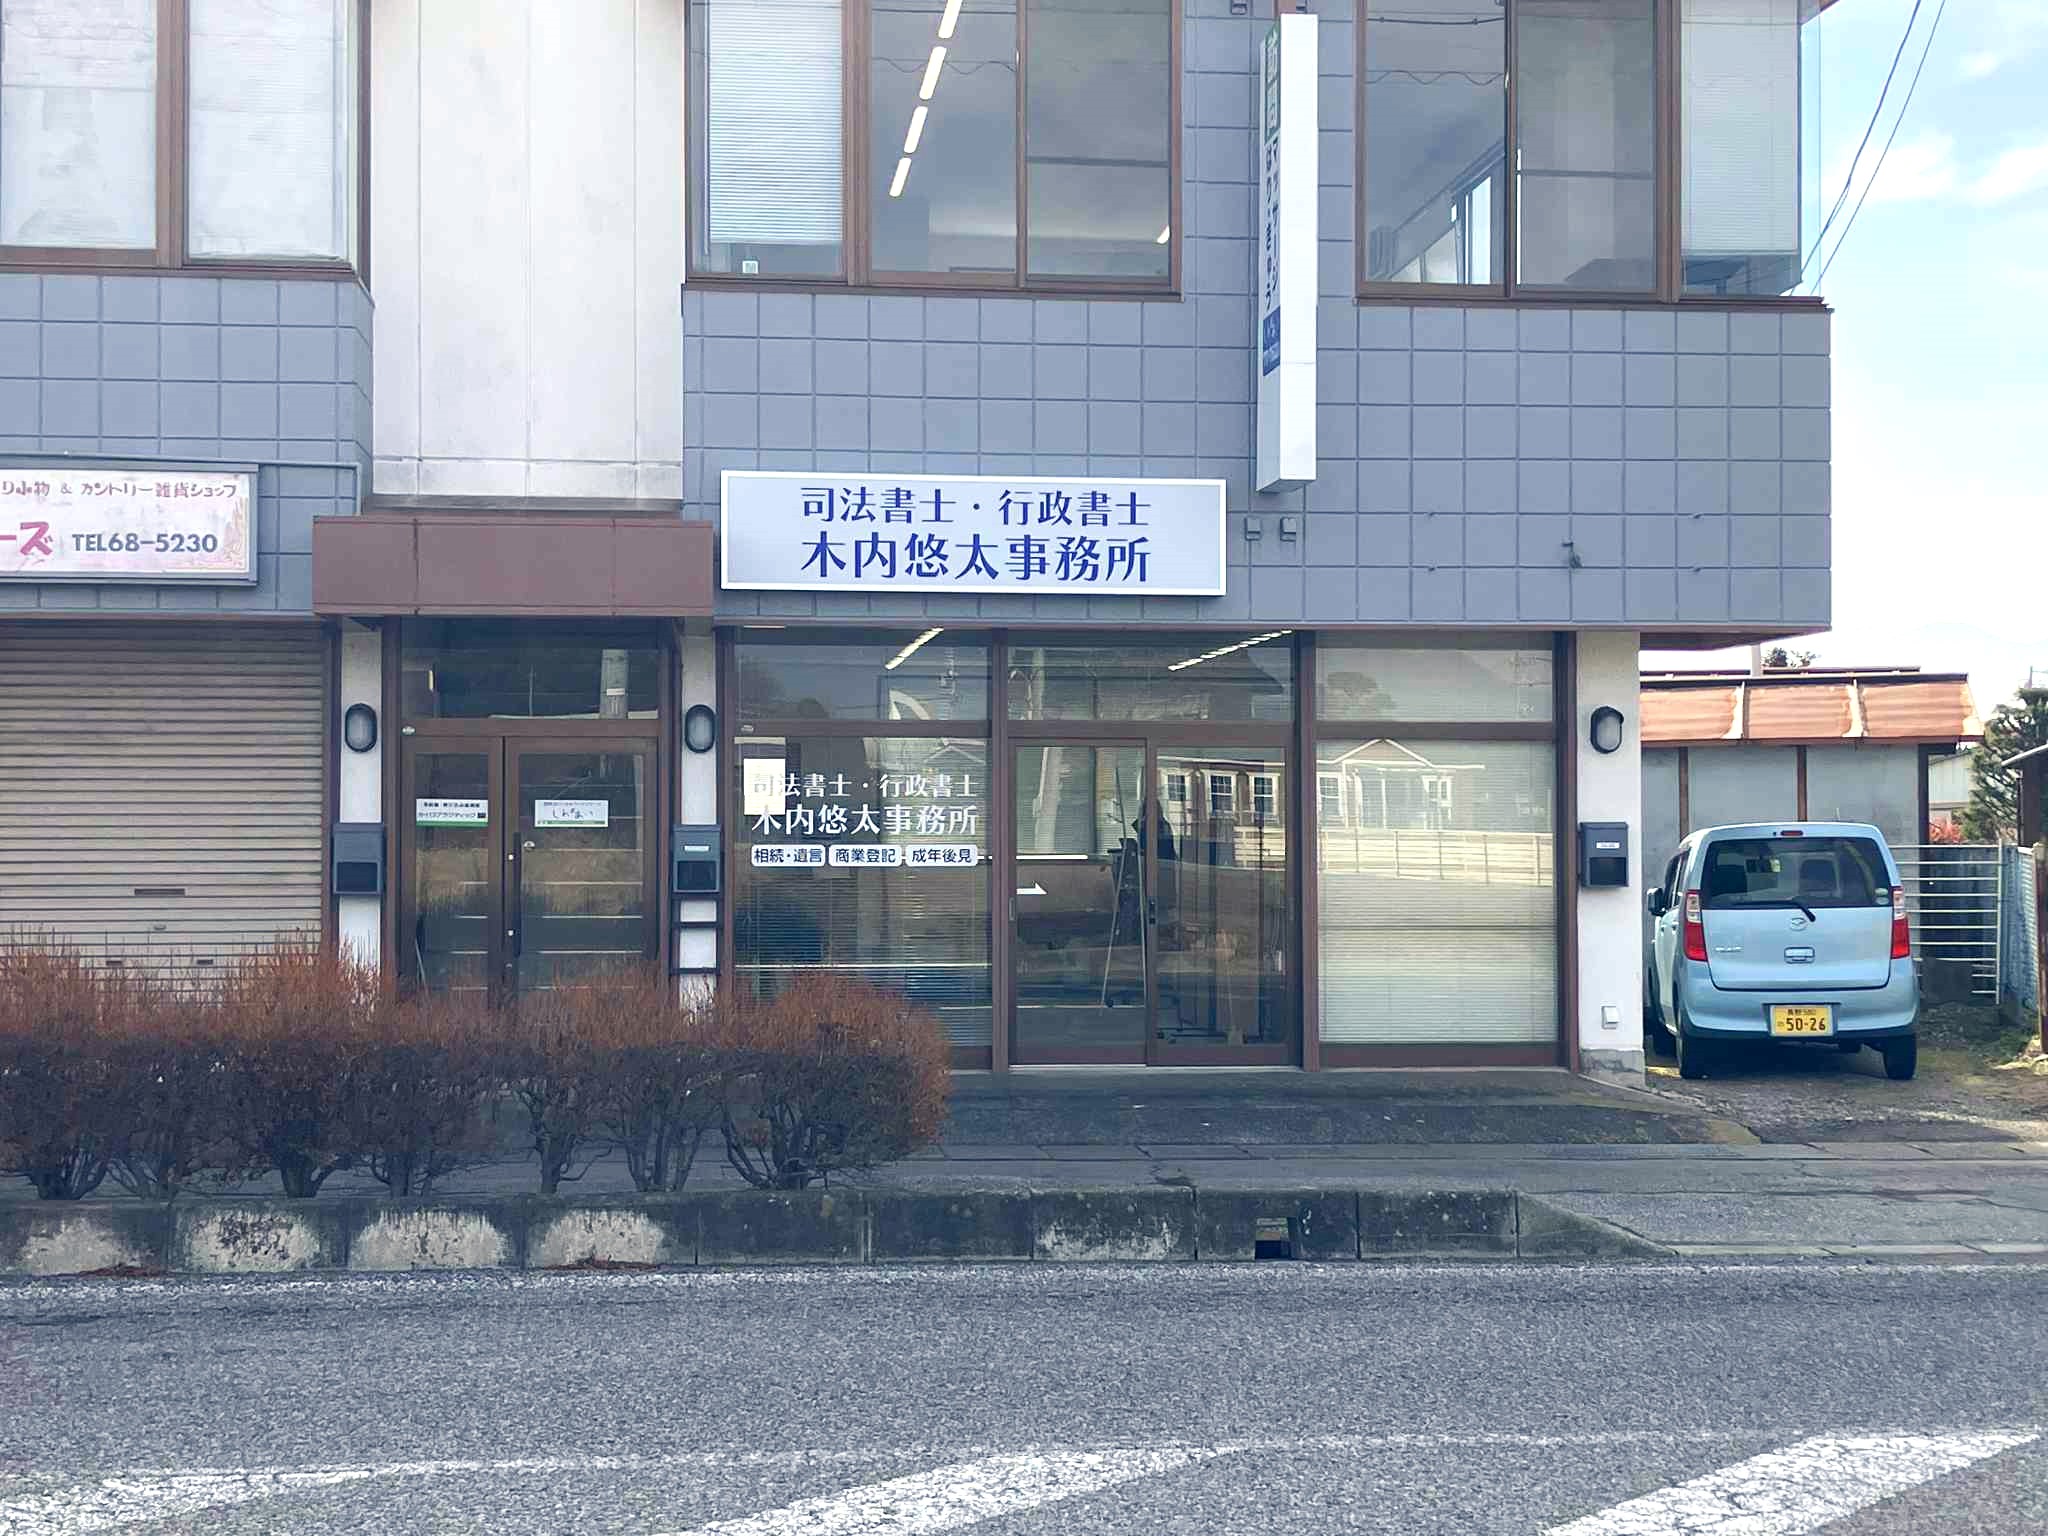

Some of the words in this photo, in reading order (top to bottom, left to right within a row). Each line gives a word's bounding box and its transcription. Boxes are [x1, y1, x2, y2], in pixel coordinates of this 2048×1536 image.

[60, 485, 73, 495] &
[801, 485, 1151, 527] 司法書士・行政書士
[800, 530, 1151, 583] 木内悠太事務所
[751, 803, 979, 836] 木内悠太事務所
[753, 848, 823, 864] 相続・遺言
[835, 848, 896, 864] 商業登記
[911, 848, 972, 864] 成年後見
[1786, 1017, 1826, 1031] 50-26
